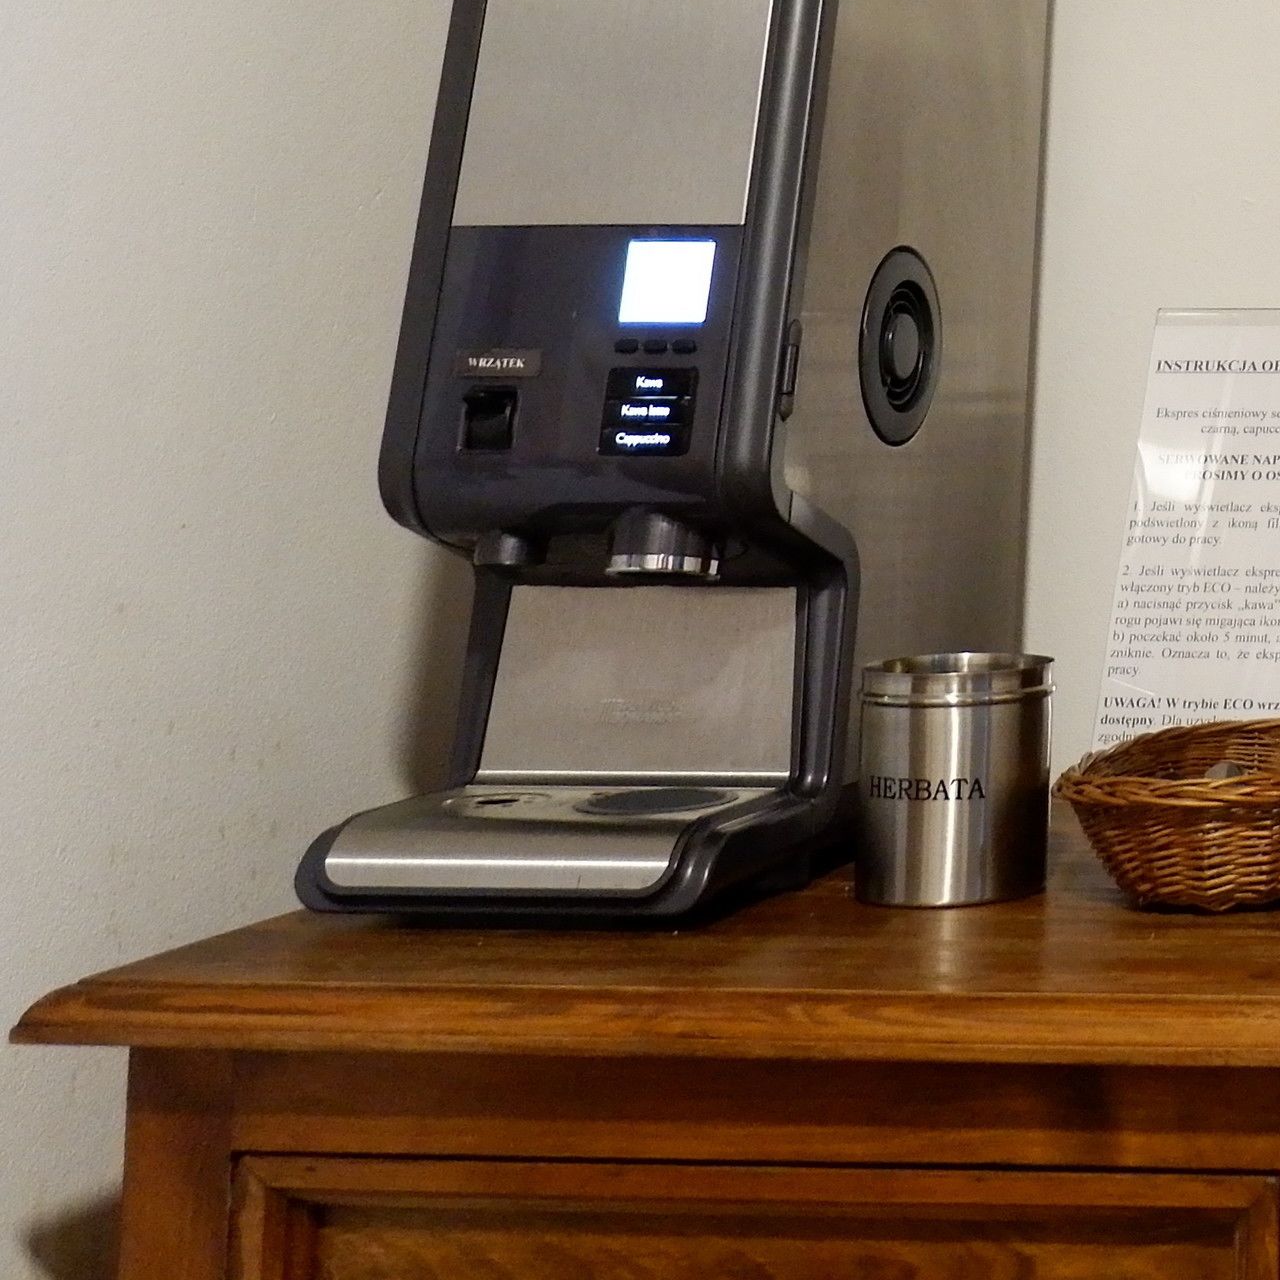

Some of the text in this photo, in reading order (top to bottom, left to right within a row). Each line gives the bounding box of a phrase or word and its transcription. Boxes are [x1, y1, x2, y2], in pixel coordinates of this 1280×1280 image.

[468, 358, 525, 370] WRZĄTEK
[1156, 359, 1258, 372] INSTRUKCJA
[636, 376, 663, 389] Kawa
[1156, 407, 1199, 420] Ekspres
[1202, 407, 1267, 420] ciśnieniowy
[1201, 425, 1240, 435] czarną,
[1185, 470, 1247, 481] ROSIMY
[1251, 470, 1262, 481] O
[1150, 501, 1175, 513] Jeśli
[1228, 519, 1258, 531] ikoną
[1126, 533, 1168, 547] gotowy
[1172, 533, 1186, 544] do
[1138, 565, 1164, 576] Jeśli
[1120, 582, 1174, 595] włączony
[1176, 583, 1201, 595] tryb
[1203, 583, 1232, 593] ECO
[1117, 600, 1129, 610] a)
[1133, 600, 1182, 612] nacisnąć
[1185, 600, 1233, 612] przycisk
[1115, 616, 1141, 629] rogu
[1144, 616, 1183, 628] pojawi
[1186, 617, 1201, 629] się
[1204, 617, 1256, 630] migająca
[1112, 631, 1125, 643] b)
[1129, 632, 1181, 644] poczekać
[1186, 632, 1218, 643] około
[1223, 633, 1230, 643] 5
[1161, 648, 1210, 660] Oznacza
[1237, 649, 1250, 660] że
[1103, 697, 1162, 709] UWAGA!
[1166, 697, 1180, 709] W
[1183, 698, 1219, 712] trybie
[1223, 699, 1254, 710] ECO
[868, 775, 986, 801] HERBATA
